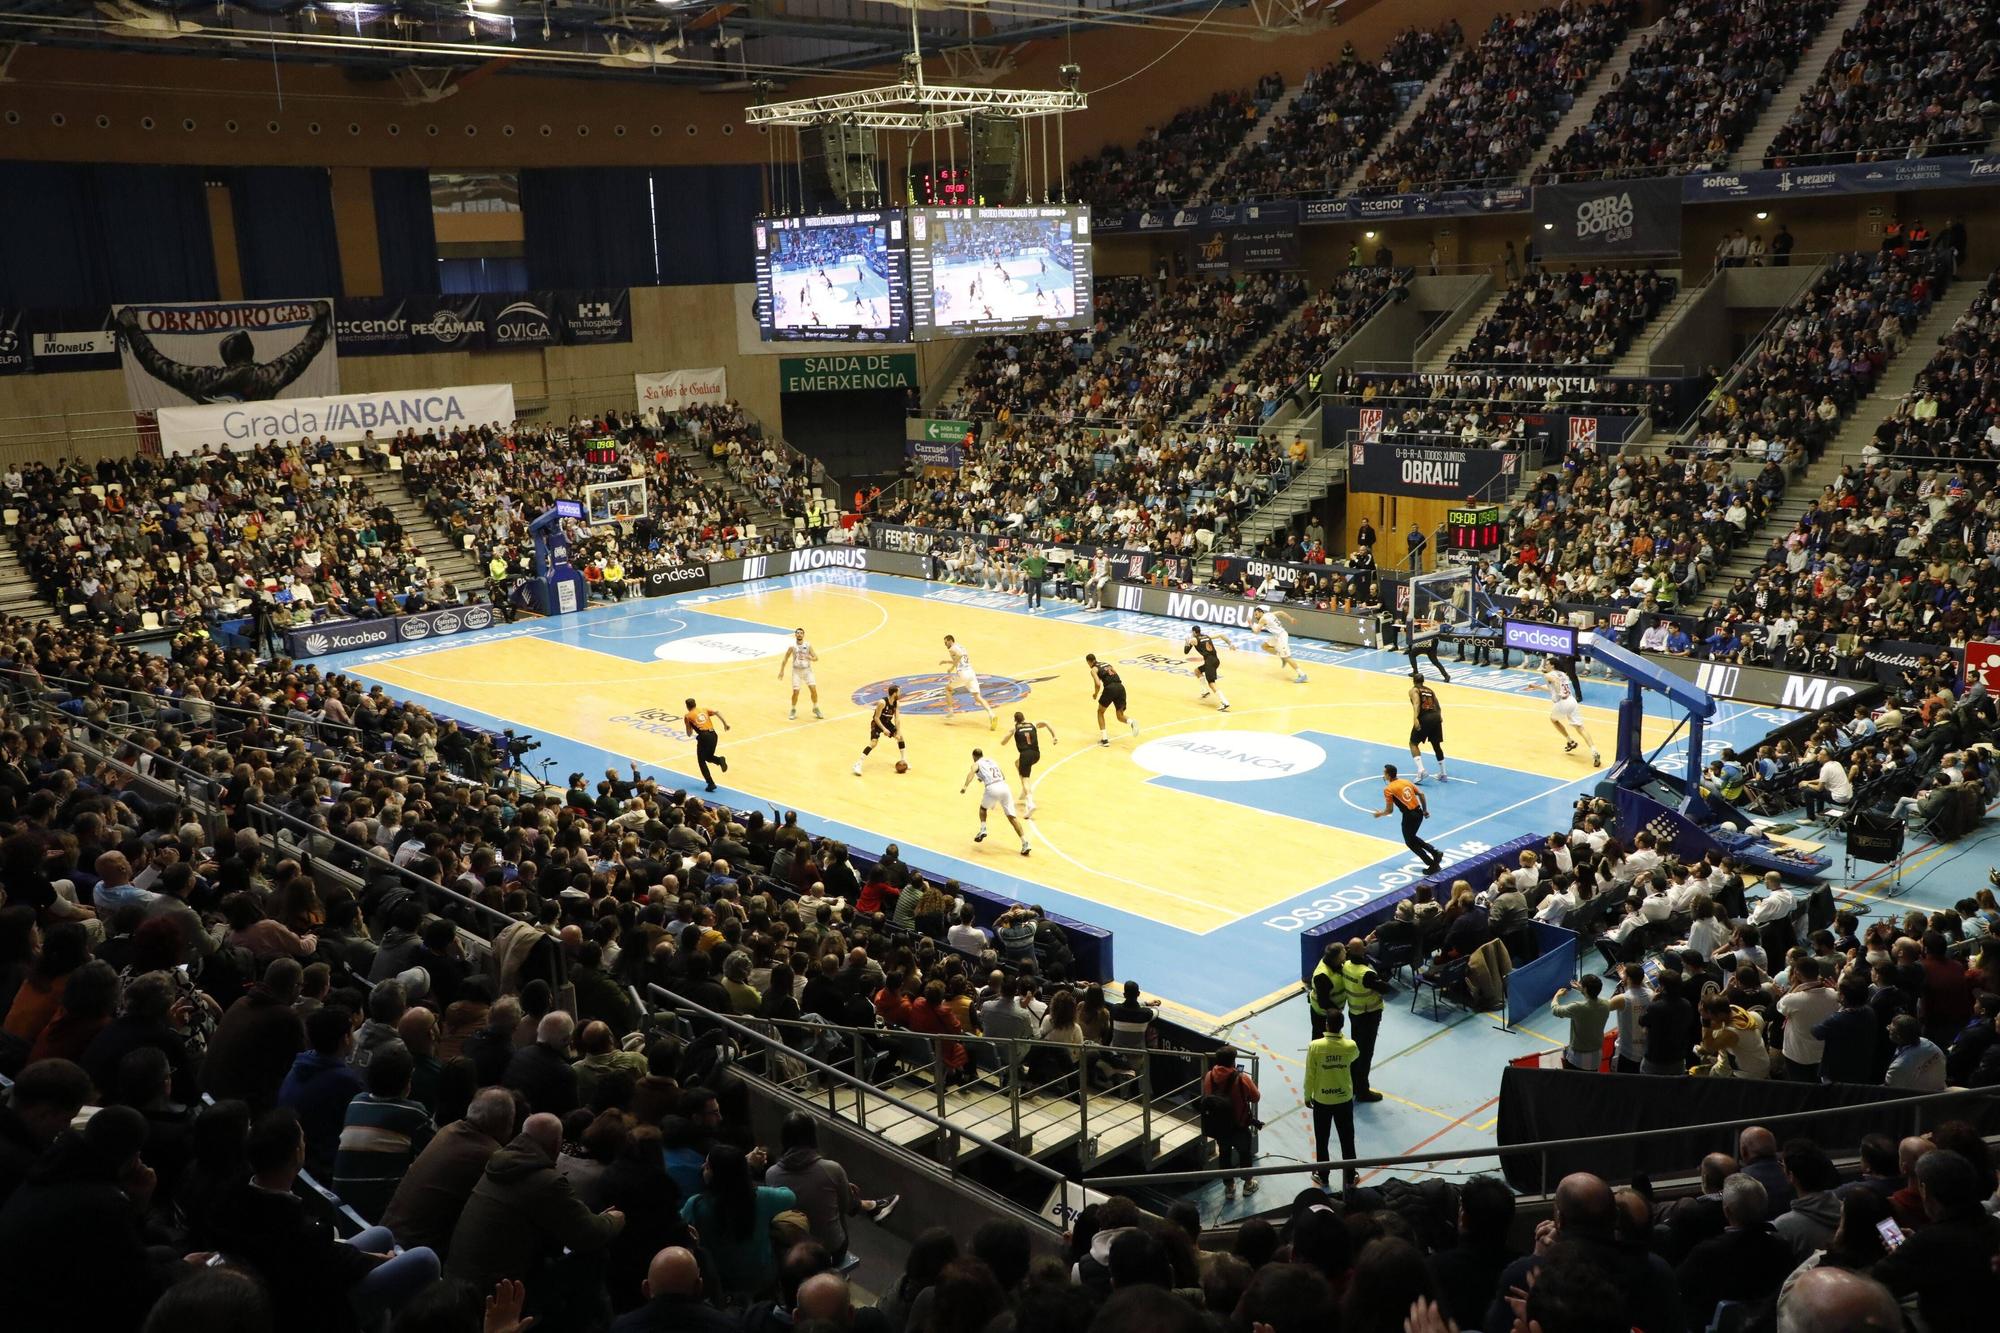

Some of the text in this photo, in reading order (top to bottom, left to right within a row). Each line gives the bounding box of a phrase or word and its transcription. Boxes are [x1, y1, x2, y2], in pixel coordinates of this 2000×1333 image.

[1703, 176, 1739, 188] Softee
[1315, 203, 1347, 213] cenor
[1369, 200, 1403, 211] cenor
[1577, 192, 1633, 221] OBRA
[1577, 210, 1633, 237] DOIRO
[147, 305, 270, 331] OBRADOIRO
[568, 318, 623, 330] hm hospitales
[351, 320, 408, 334] cenor
[411, 320, 486, 336] PESCAMAR
[497, 324, 550, 339] OVIGA
[804, 355, 891, 373] SAIDA DE
[680, 382, 688, 396] de
[690, 382, 721, 396] Galicia
[789, 372, 908, 392] EMERXENCIA
[223, 408, 318, 440] Grada
[914, 443, 947, 453] Carrusel
[1424, 450, 1443, 461] TODOS
[1402, 459, 1460, 486] OBRA!!!
[557, 503, 581, 514] endesa
[1450, 512, 1477, 525] 09:08
[789, 548, 867, 572] MONBUS
[652, 565, 705, 584] endesa
[1167, 592, 1270, 627] MONBU
[332, 631, 387, 648] Xacobeo
[1452, 635, 1495, 648] endesa
[1508, 628, 1570, 649] endesa
[634, 708, 684, 722] liga
[1325, 1055, 1342, 1063] STAFF
